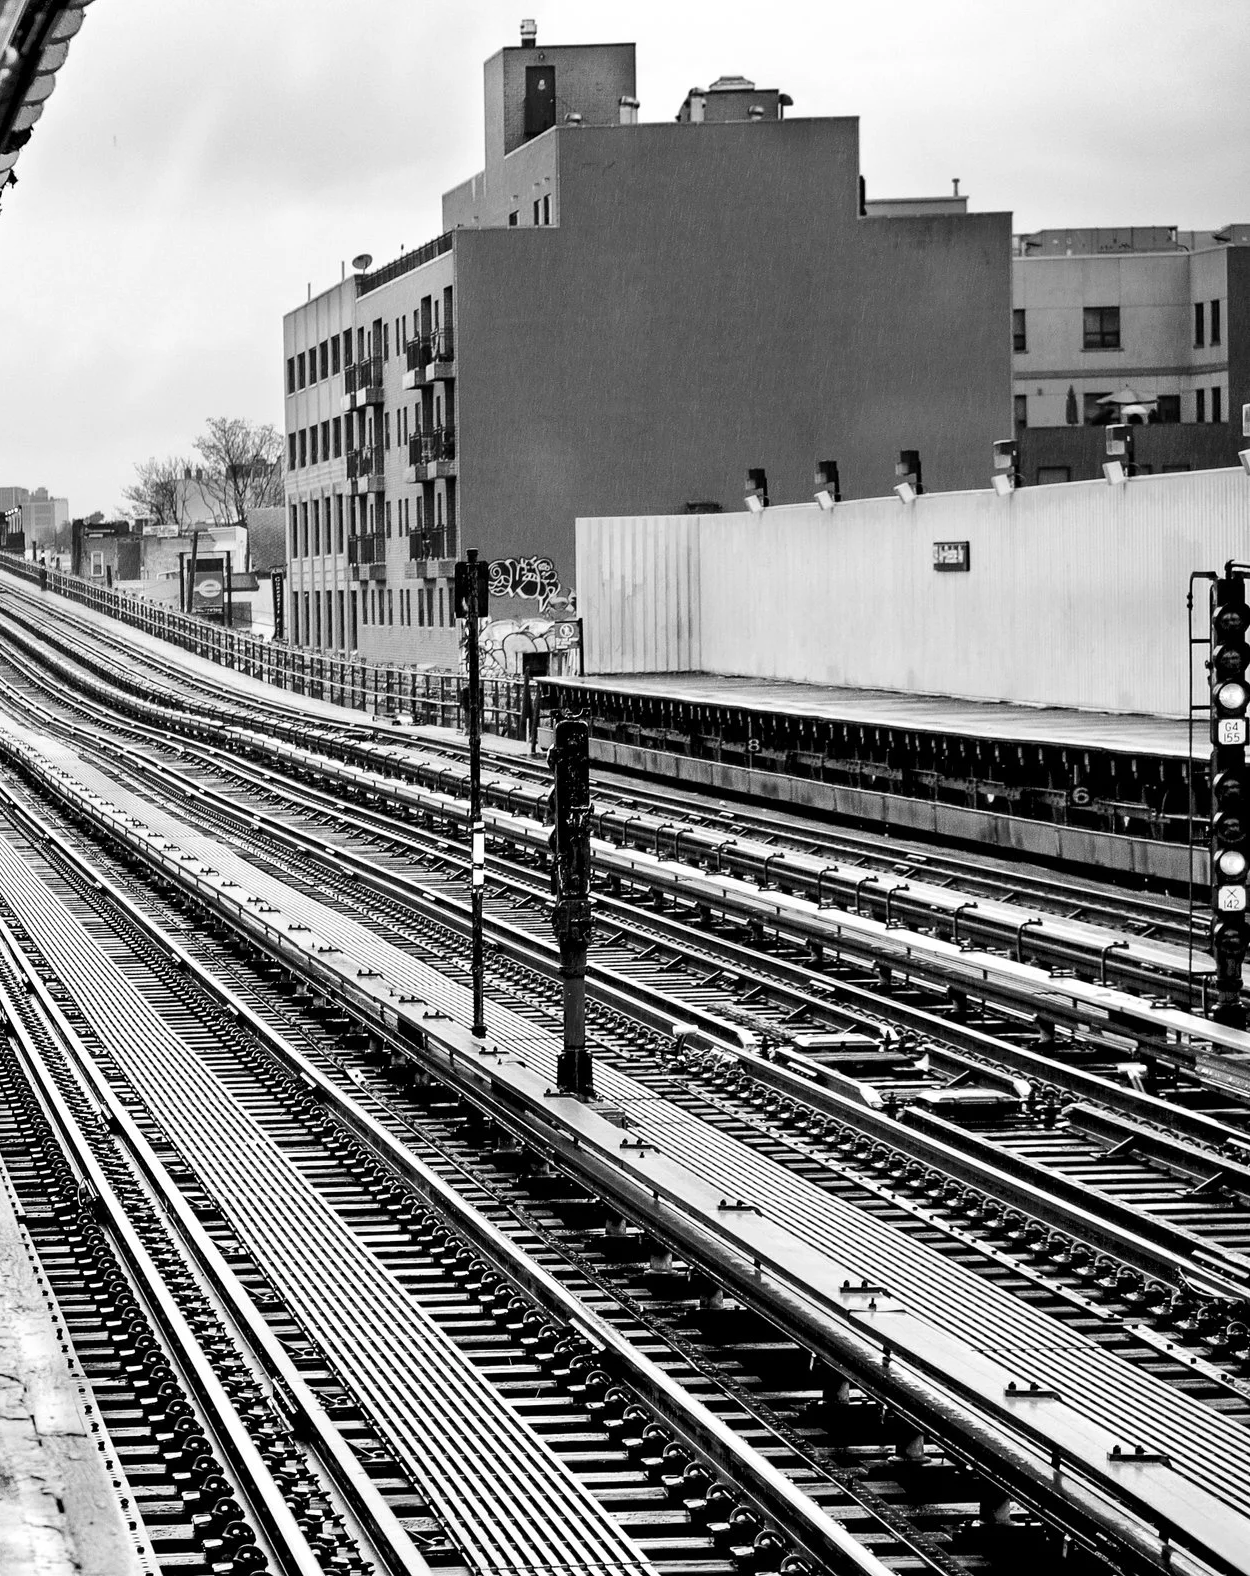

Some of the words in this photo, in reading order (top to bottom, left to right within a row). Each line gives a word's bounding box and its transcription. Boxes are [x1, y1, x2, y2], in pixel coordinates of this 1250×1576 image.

[1225, 721, 1239, 732] G4
[1223, 732, 1241, 743] 155
[748, 738, 760, 751] 8
[1072, 786, 1090, 804] 6
[1223, 899, 1240, 910] 142
